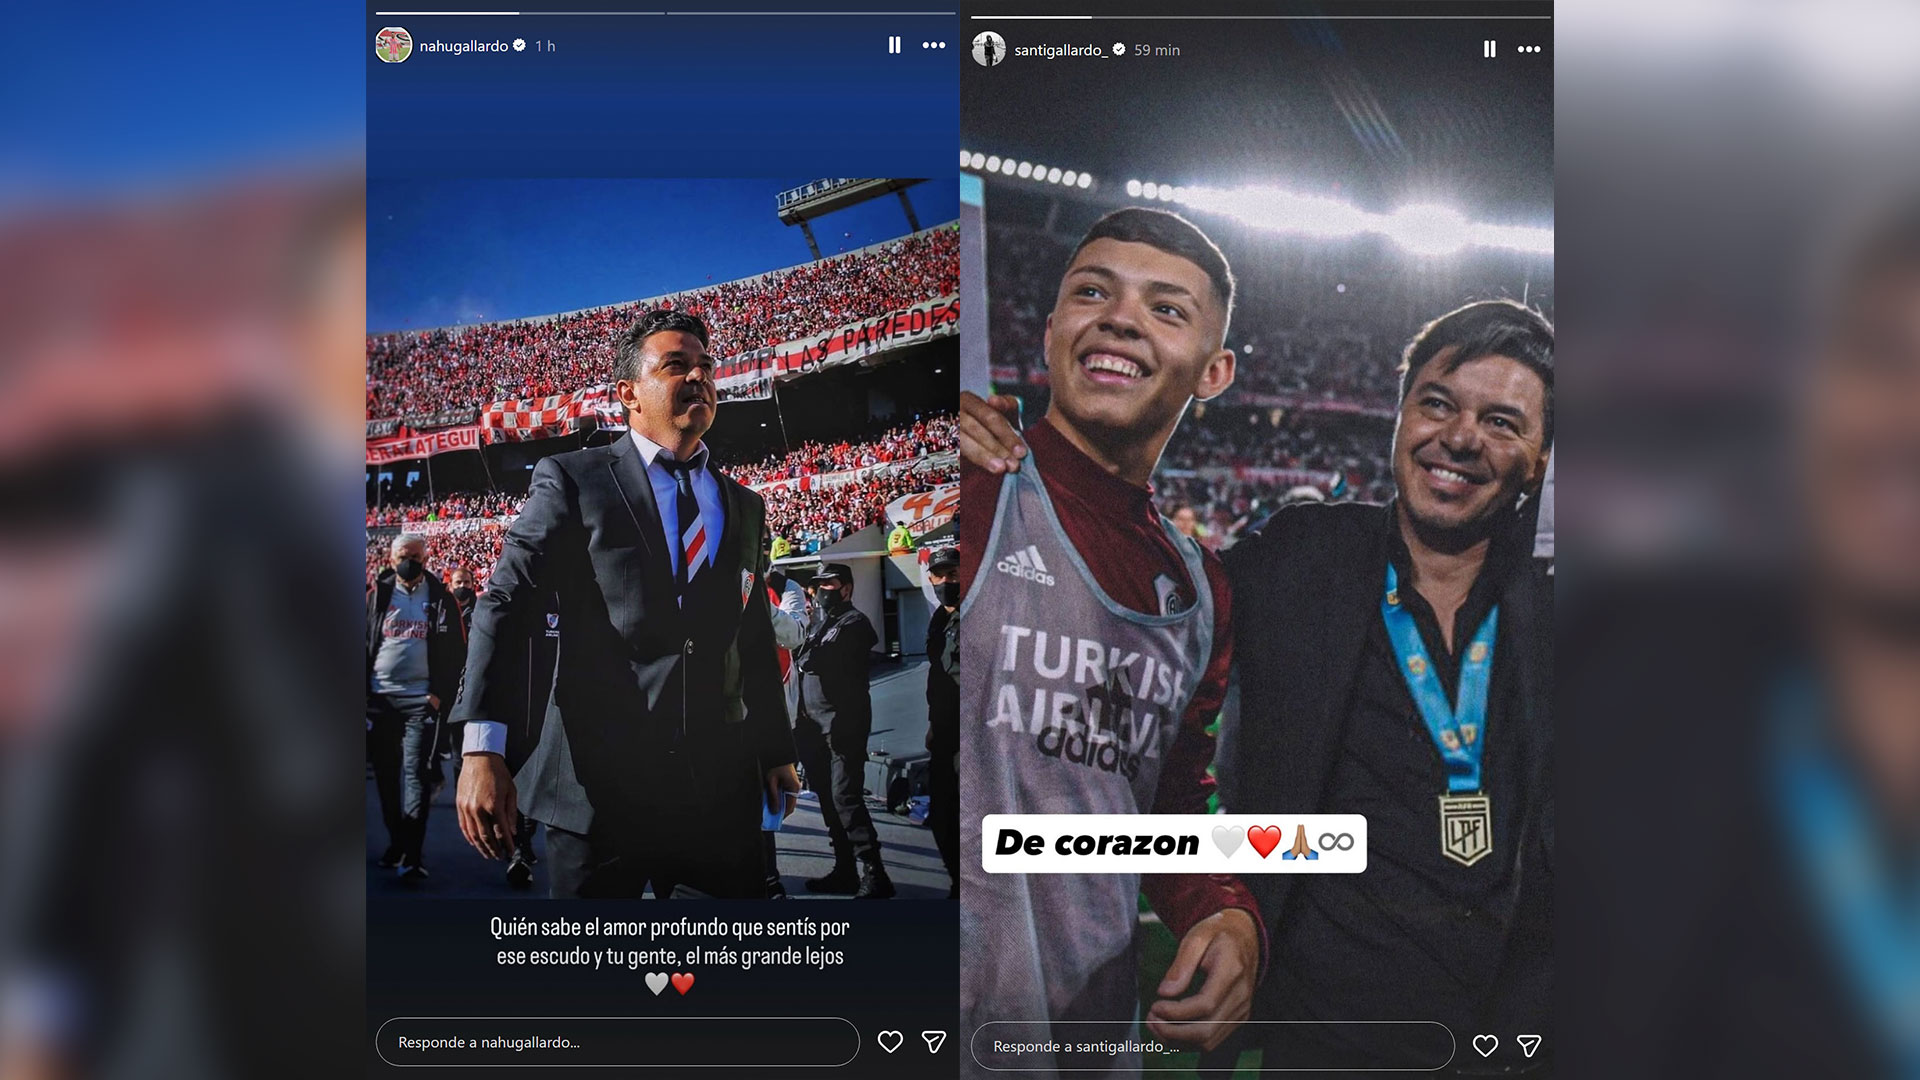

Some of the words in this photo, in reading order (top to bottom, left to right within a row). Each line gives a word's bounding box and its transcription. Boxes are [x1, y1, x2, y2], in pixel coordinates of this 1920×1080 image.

[785, 338, 830, 374] LAS
[843, 298, 960, 355] PAREDES
[366, 429, 476, 461] ERAZATEGUI
[997, 560, 1055, 587] adidas
